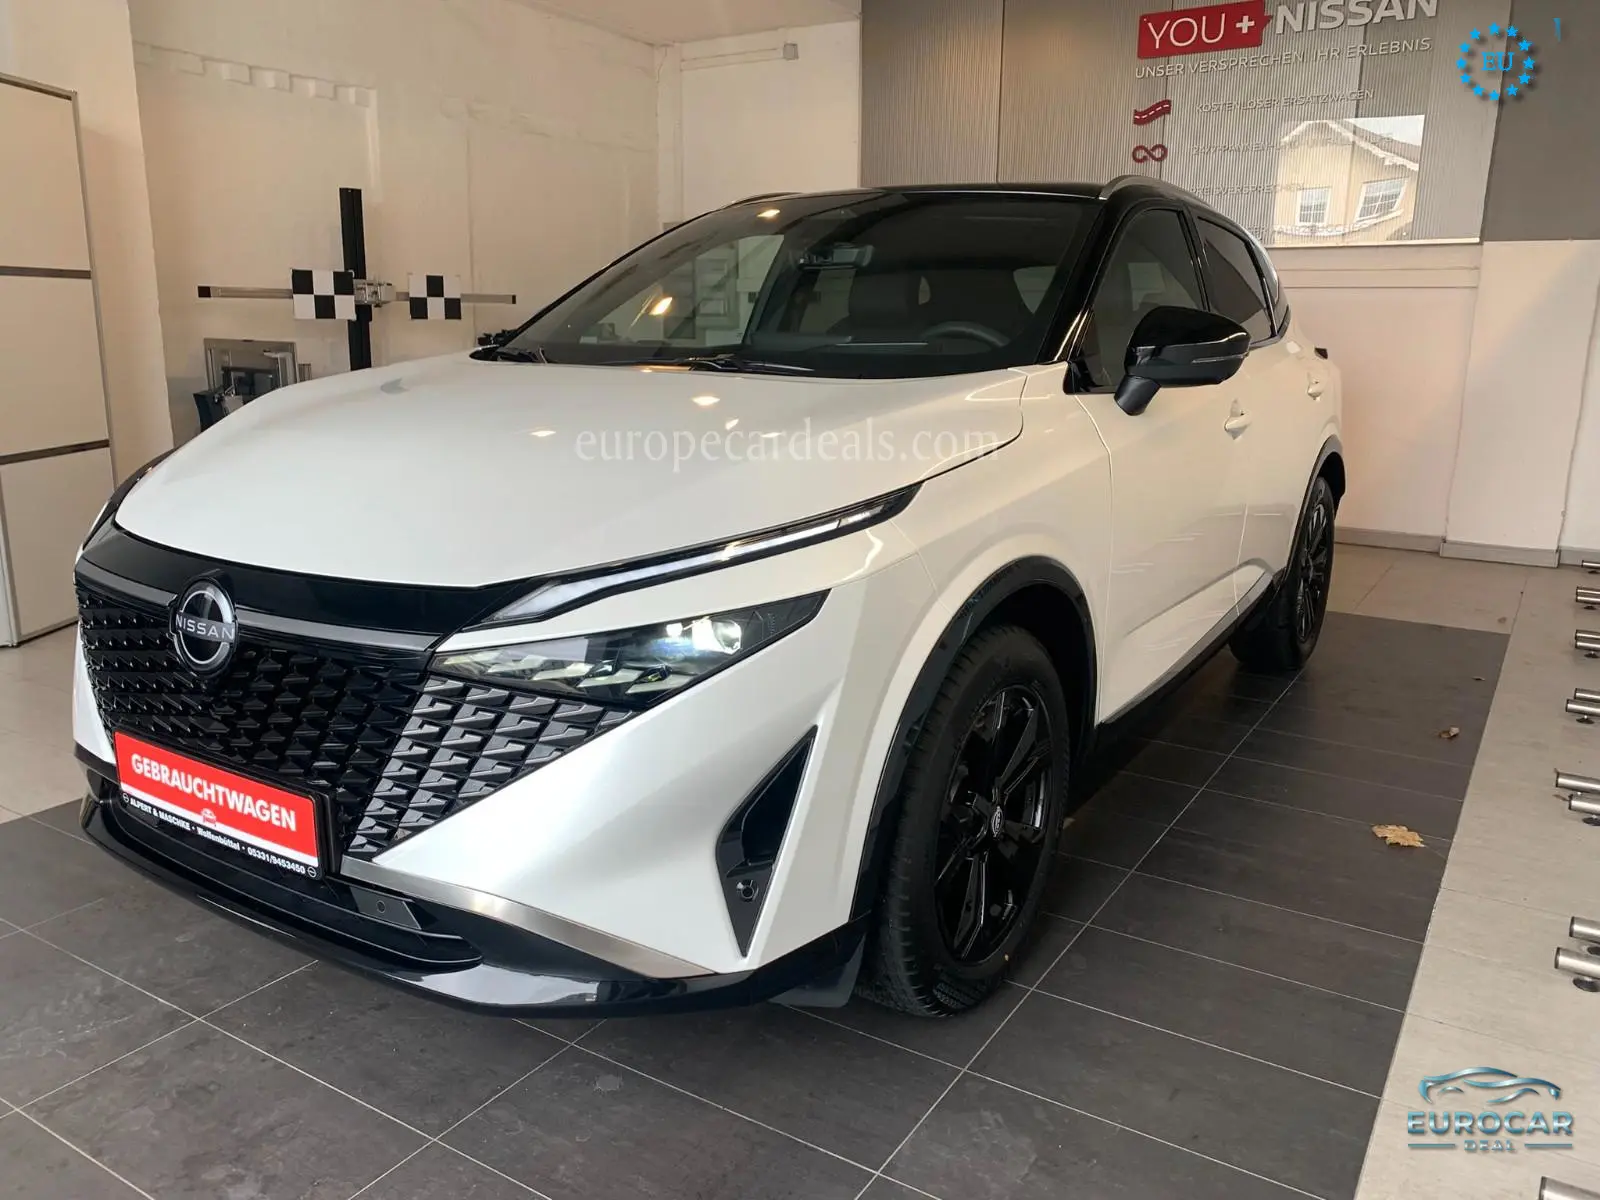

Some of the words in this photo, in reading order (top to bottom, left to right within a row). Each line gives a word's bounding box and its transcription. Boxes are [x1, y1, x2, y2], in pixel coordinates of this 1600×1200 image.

[1148, 12, 1226, 49] YOU
[1275, 0, 1440, 35] NISSAN
[1135, 62, 1184, 79] UNSER
[1314, 46, 1340, 61] IHR
[1196, 97, 1279, 114] KOSTENLOSER
[1281, 88, 1376, 107] ERSATZWAGEN
[176, 613, 235, 640] NISSAN
[131, 753, 297, 832] GEBRAUCHTWAGEN
